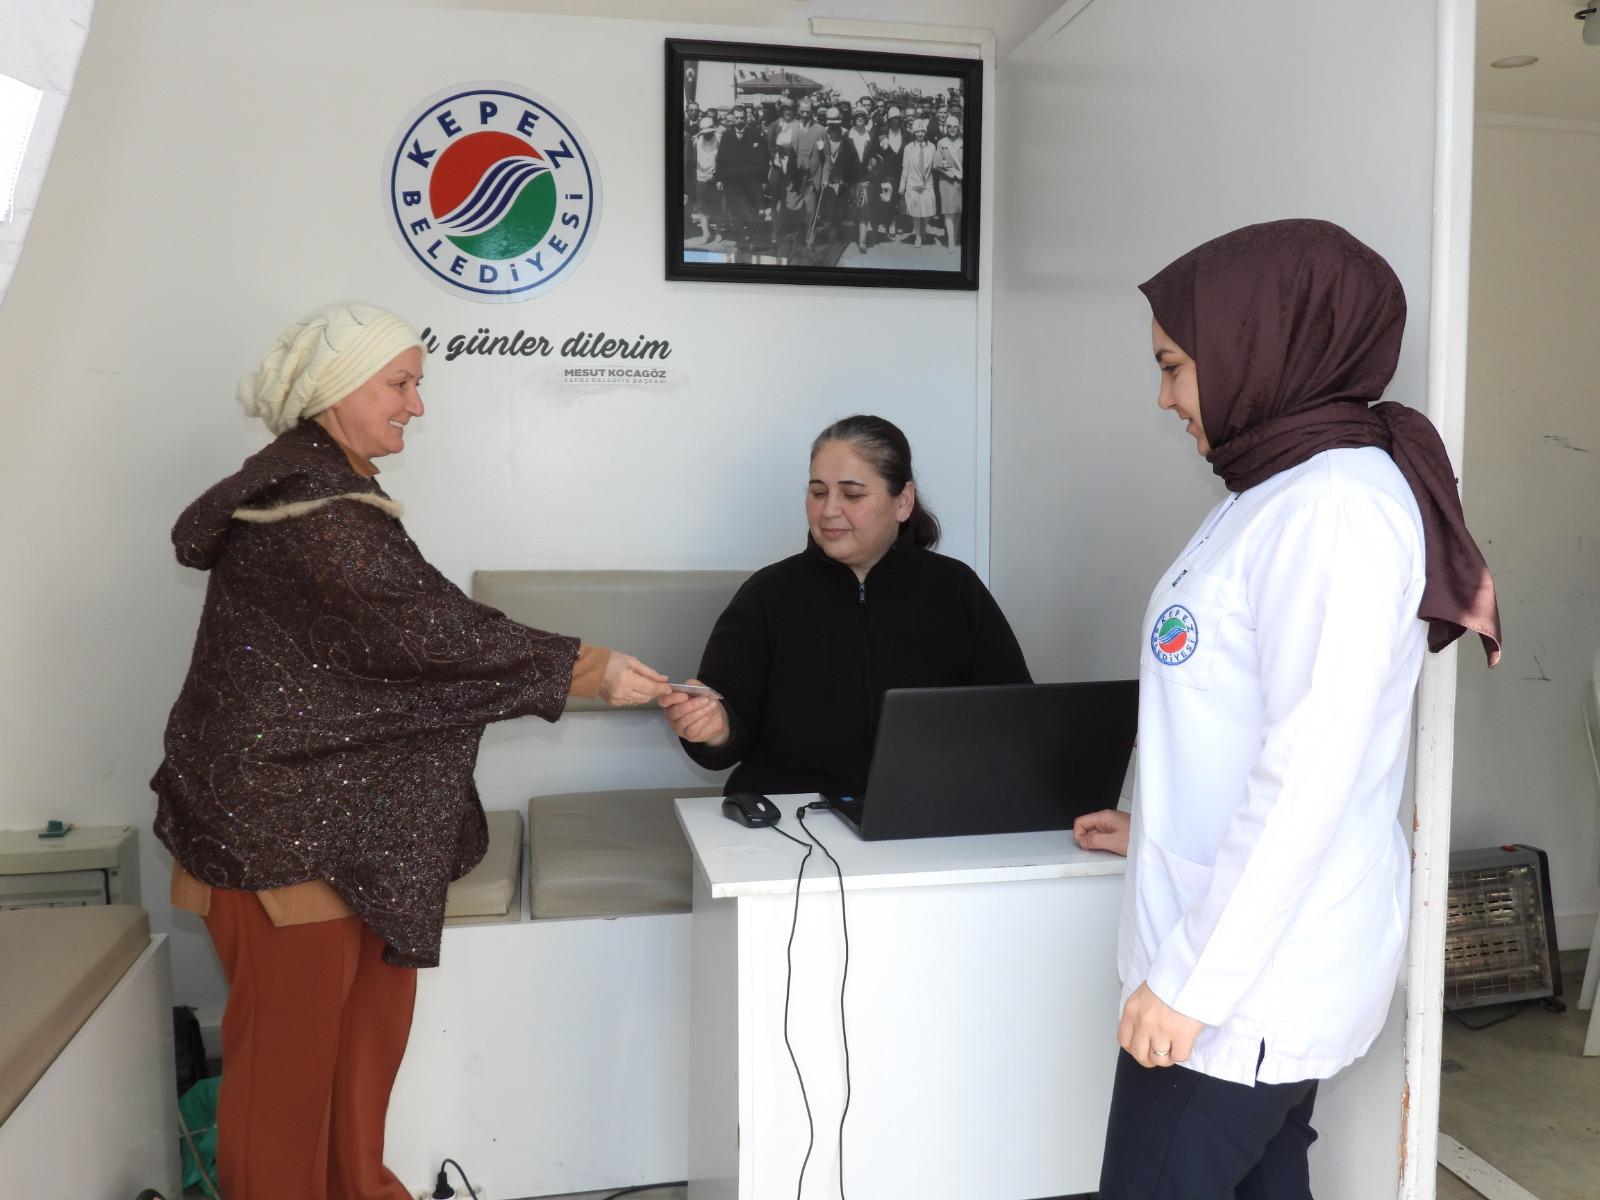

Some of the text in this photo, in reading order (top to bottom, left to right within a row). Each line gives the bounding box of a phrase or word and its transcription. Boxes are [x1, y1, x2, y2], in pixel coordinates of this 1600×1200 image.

[407, 101, 575, 168] KEPEZ
[445, 327, 553, 361] günler
[560, 331, 672, 360] dilerim
[564, 368, 666, 378] MESUT KOCAGÖZ
[1161, 608, 1194, 633] KEPEZ
